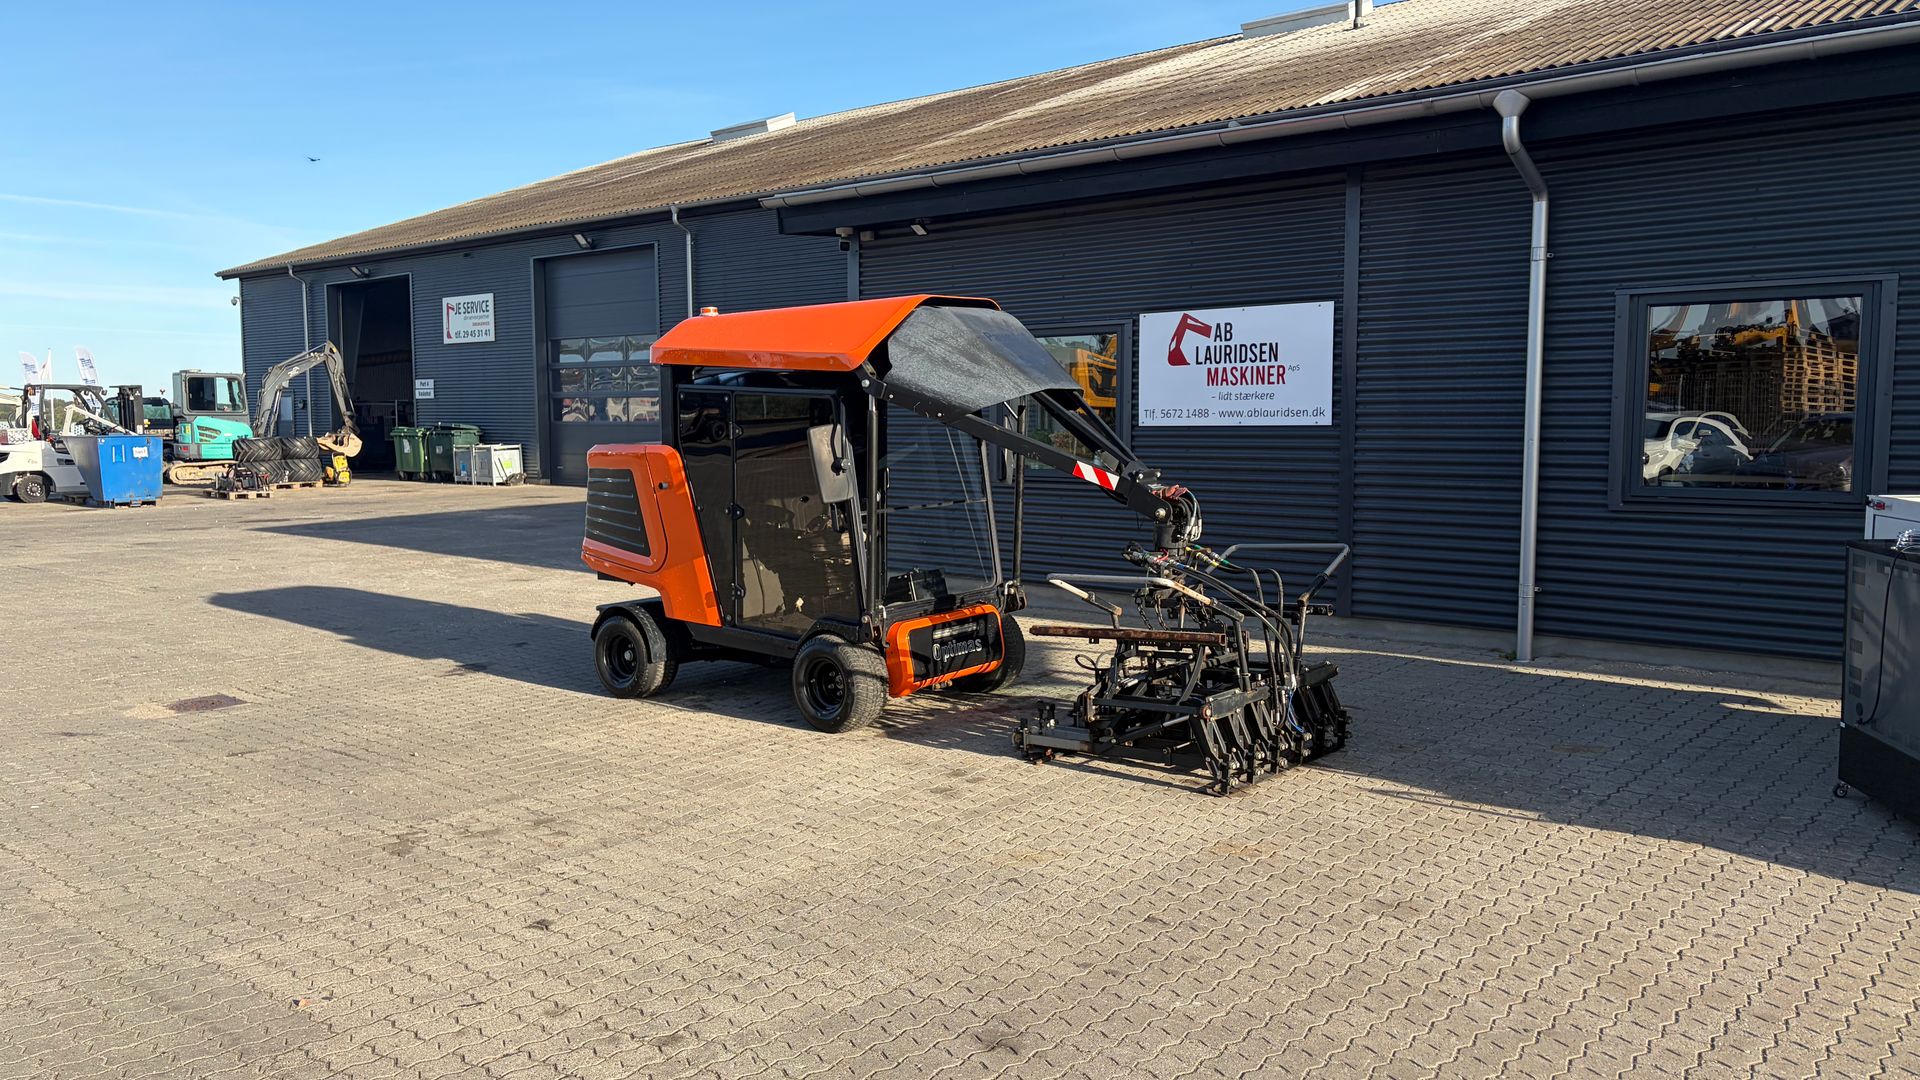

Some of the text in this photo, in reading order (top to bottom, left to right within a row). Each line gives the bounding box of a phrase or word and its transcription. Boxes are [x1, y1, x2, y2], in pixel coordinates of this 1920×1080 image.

[455, 300, 490, 315] JE SERVICE
[463, 330, 470, 338] 29
[470, 329, 477, 338] 45
[477, 329, 484, 337] 31
[484, 329, 491, 337] 41
[1213, 322, 1233, 342] AB
[1195, 342, 1279, 365] LAURIDSEN
[1206, 364, 1300, 387] MASKINER ApS
[1218, 391, 1232, 401] lidt
[1234, 391, 1275, 401] stærkere
[1144, 409, 1158, 420] Tlf.
[1160, 409, 1183, 419] 5672
[1185, 408, 1210, 418] 1488
[1218, 406, 1326, 419] www.ablauridsen.dk
[932, 639, 982, 662] Optimas
